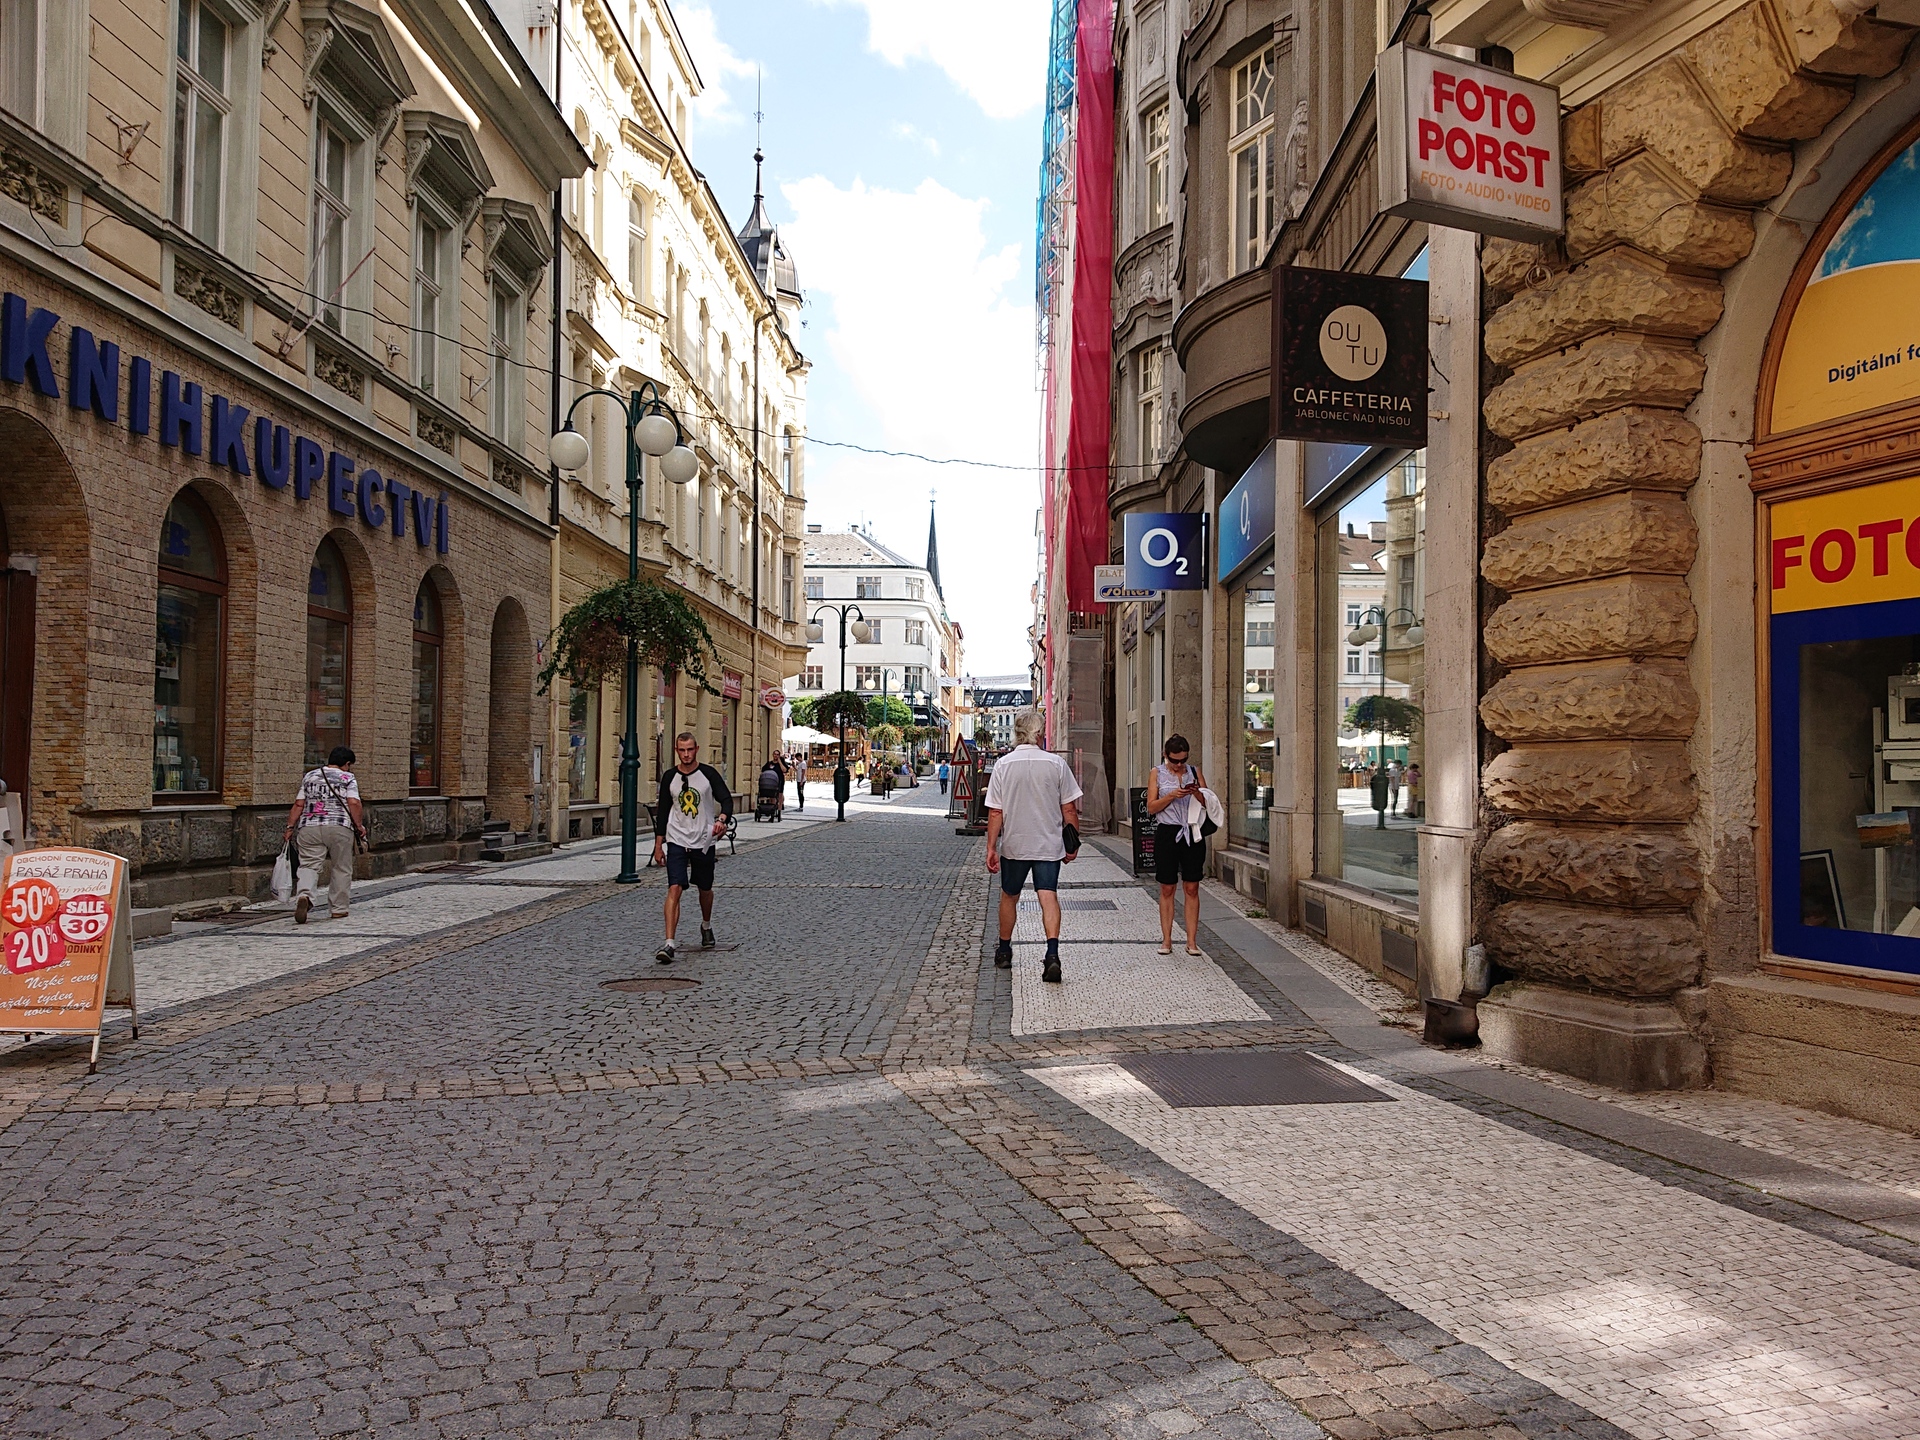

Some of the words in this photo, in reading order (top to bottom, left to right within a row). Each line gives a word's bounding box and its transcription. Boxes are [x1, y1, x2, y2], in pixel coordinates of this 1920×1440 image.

[1433, 70, 1536, 135] FOTO
[1418, 118, 1550, 188] PORST
[1421, 170, 1456, 191] FOTO
[1465, 181, 1505, 202] AUDIO
[1514, 192, 1551, 213] VIDEO
[1328, 321, 1361, 342] OU
[1346, 344, 1378, 365] TU
[1828, 347, 1902, 383] Digitální
[1293, 387, 1412, 412] CAFFETERIA
[2, 292, 449, 554] KNIHKUPECTVÍ
[1295, 408, 1349, 422] JABLONEC
[1353, 413, 1375, 423] NAD
[1378, 415, 1411, 426] NISOU
[1099, 569, 1124, 577] ZLAT
[16, 854, 62, 864] OBCHODNÍ
[65, 856, 110, 867] CENTRUM
[16, 865, 60, 878] PASÁŽ
[63, 868, 108, 879] PRAHA
[6, 885, 54, 923] -50%
[66, 901, 105, 914] SALE
[62, 919, 106, 934] -30%
[10, 924, 58, 968] -20%
[24, 974, 65, 990] Nízké
[70, 972, 99, 984] ceny
[0, 994, 31, 1011] aždý
[37, 990, 74, 1005] týden
[24, 1005, 54, 1017] nové
